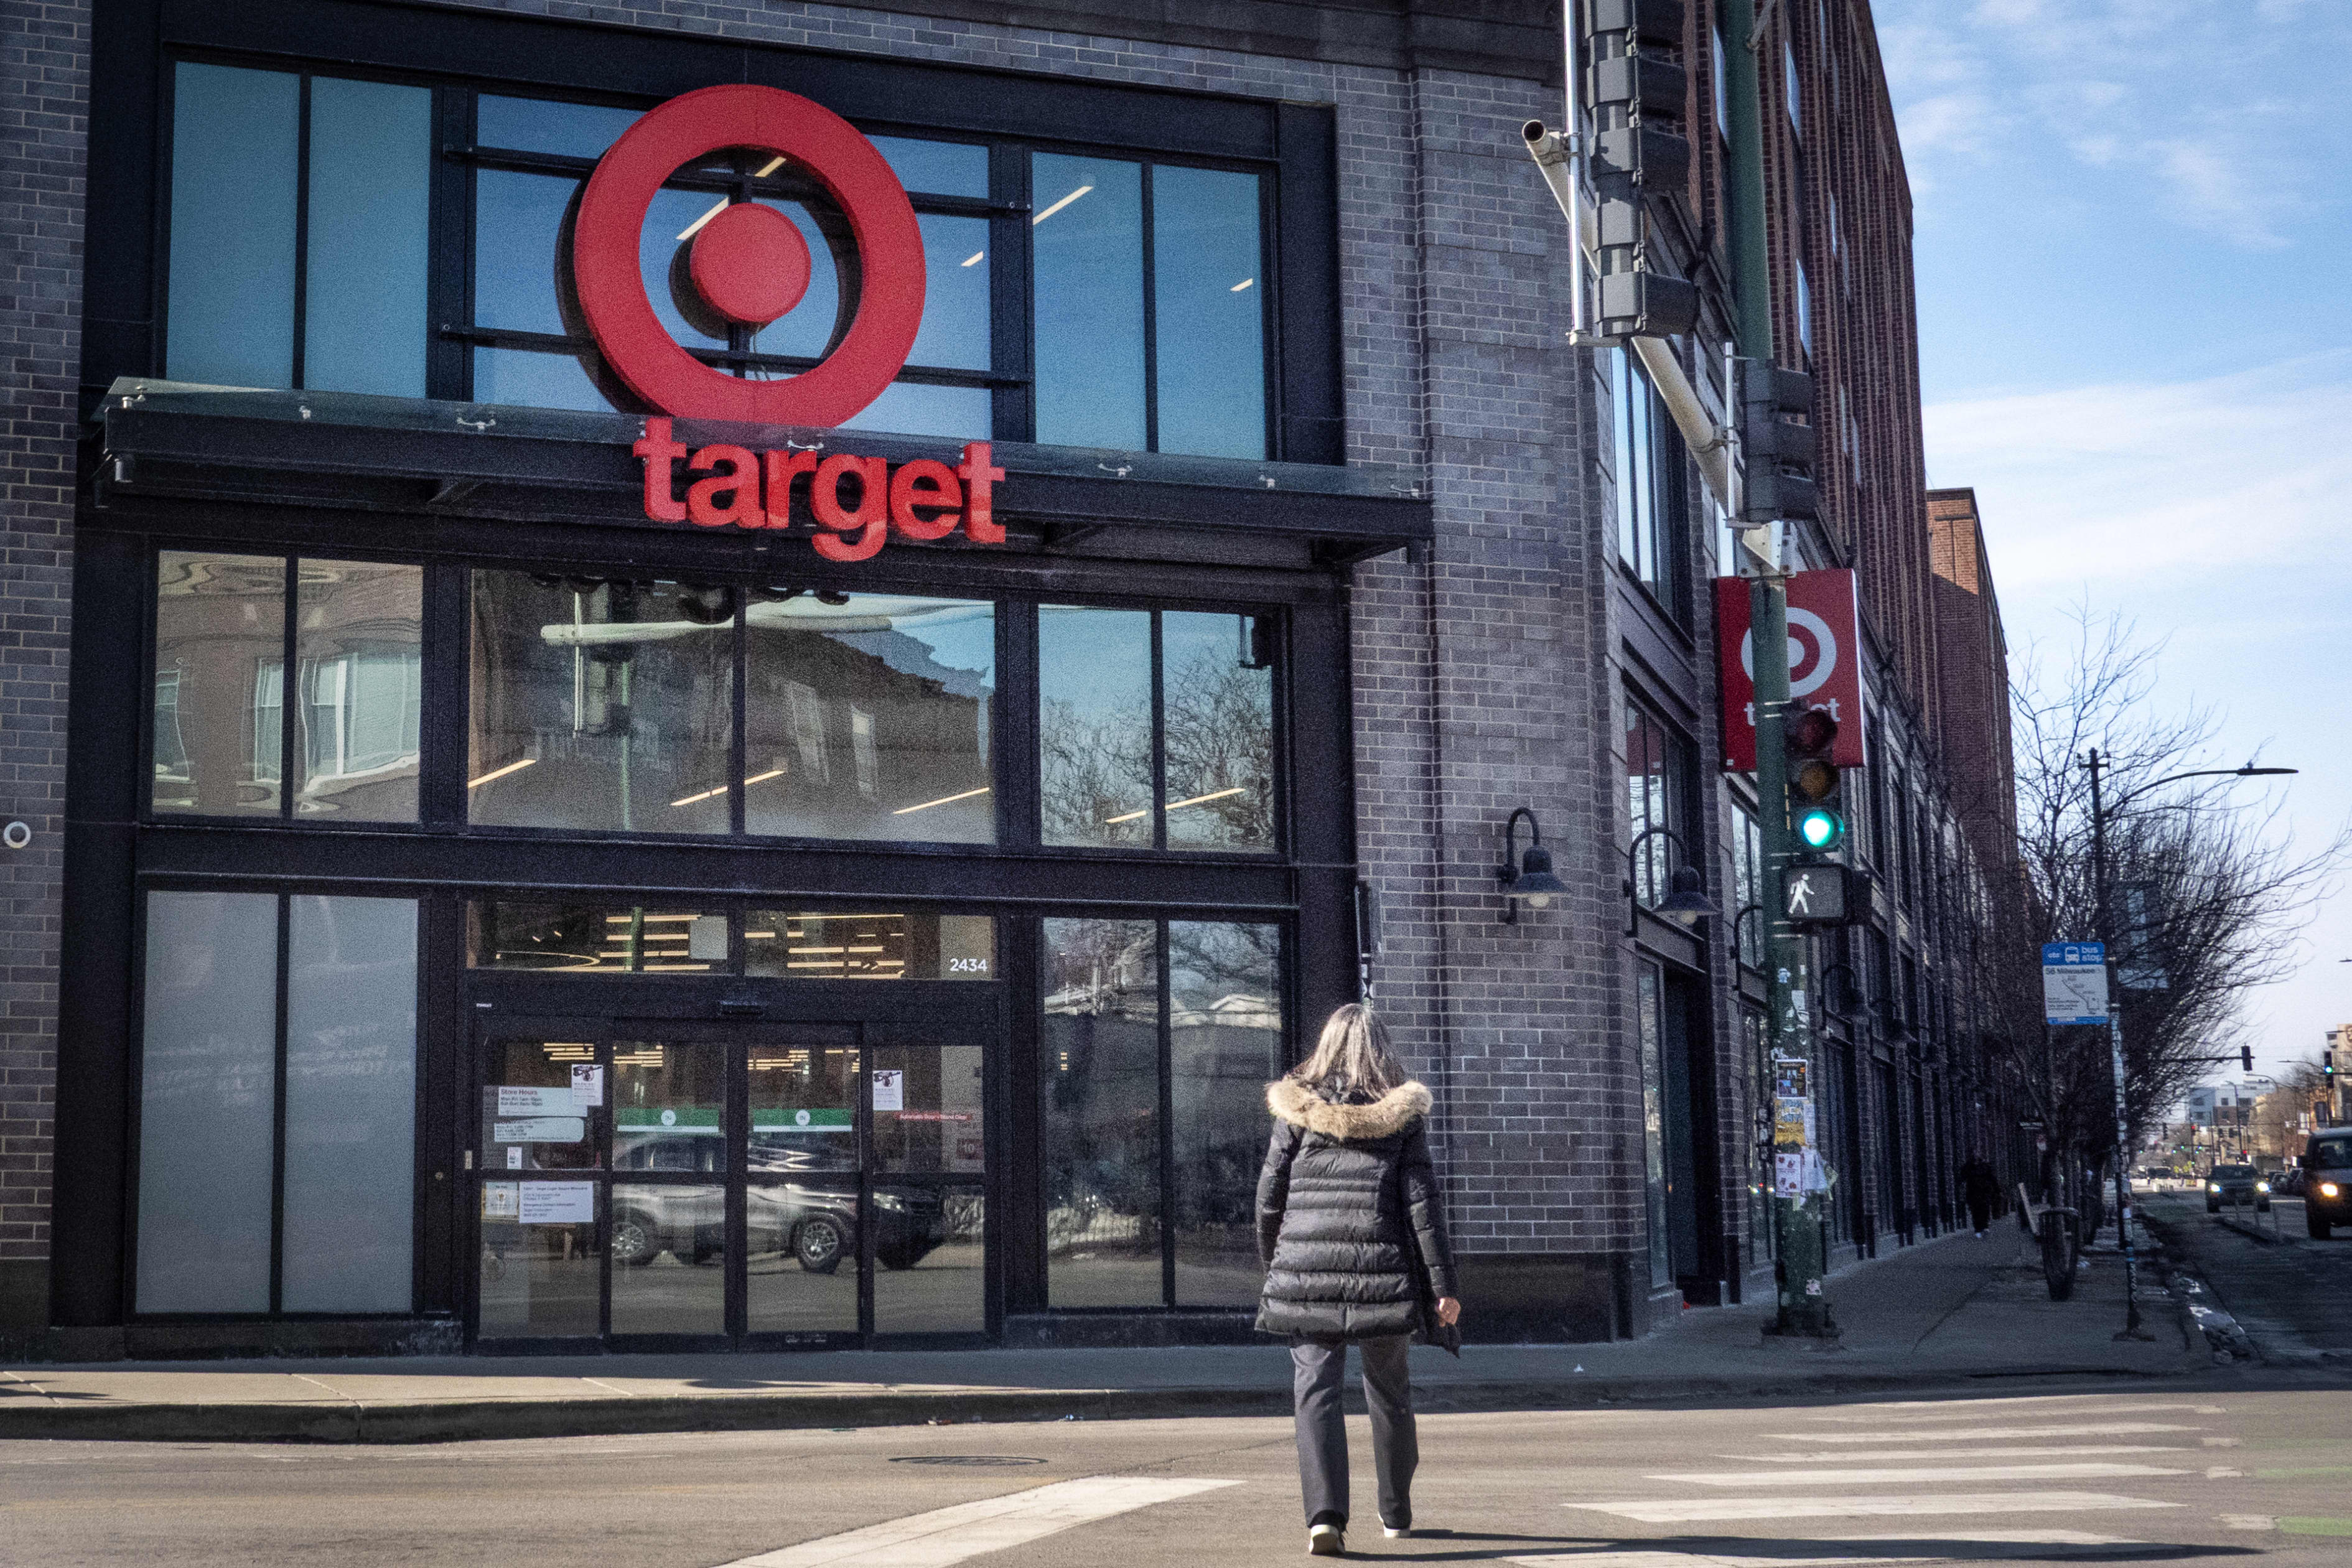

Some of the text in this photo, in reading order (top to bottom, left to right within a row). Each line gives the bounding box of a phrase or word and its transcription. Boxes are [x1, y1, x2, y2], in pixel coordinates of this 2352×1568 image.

[633, 416, 1006, 562] target
[950, 958, 988, 972] 2434
[2081, 954, 2102, 963] stop
